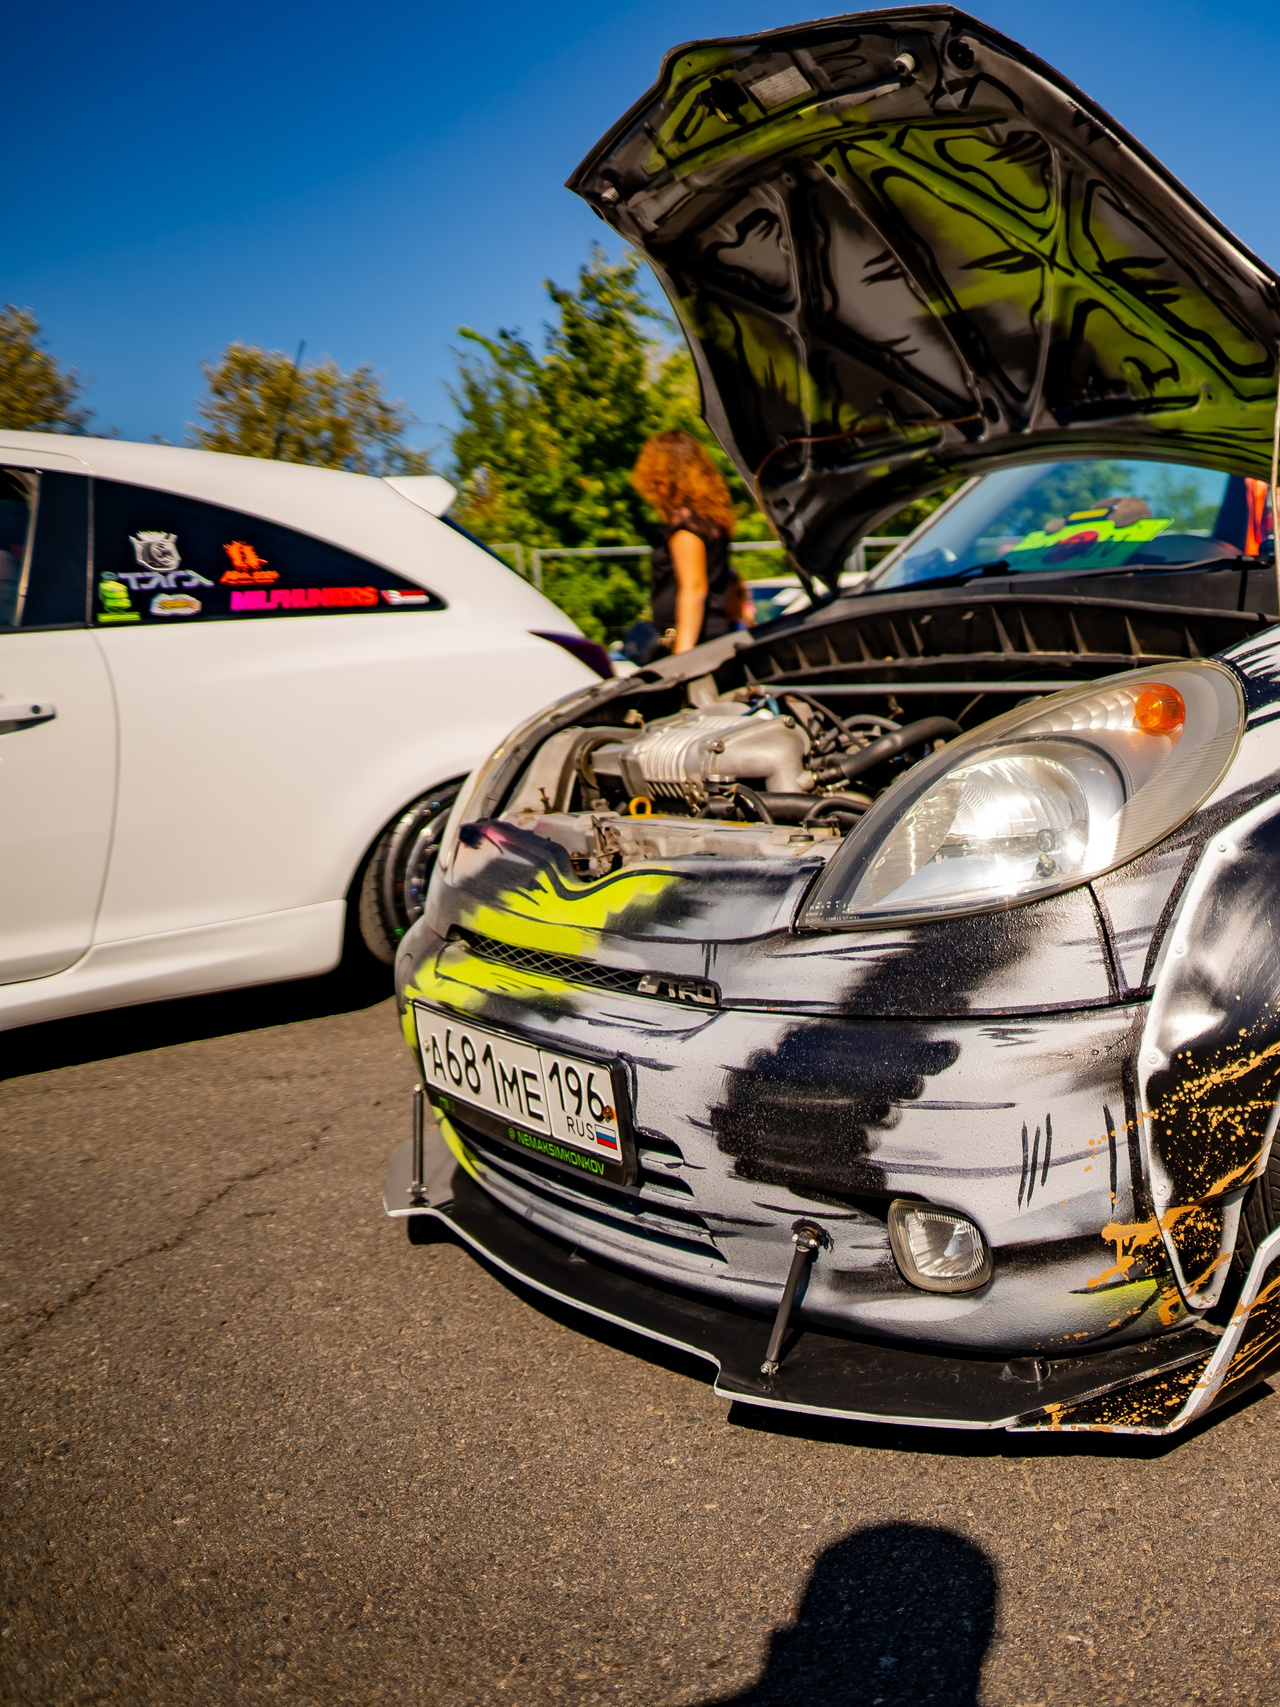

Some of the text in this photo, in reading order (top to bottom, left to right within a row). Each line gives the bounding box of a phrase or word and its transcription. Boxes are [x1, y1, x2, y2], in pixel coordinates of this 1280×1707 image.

[229, 586, 379, 612] MILFHUNTERS
[661, 978, 717, 1005] TRD
[431, 1027, 606, 1122] A681ME 196
[566, 1116, 595, 1141] RUS
[517, 1131, 605, 1176] NEMAKSIMKONKOV
